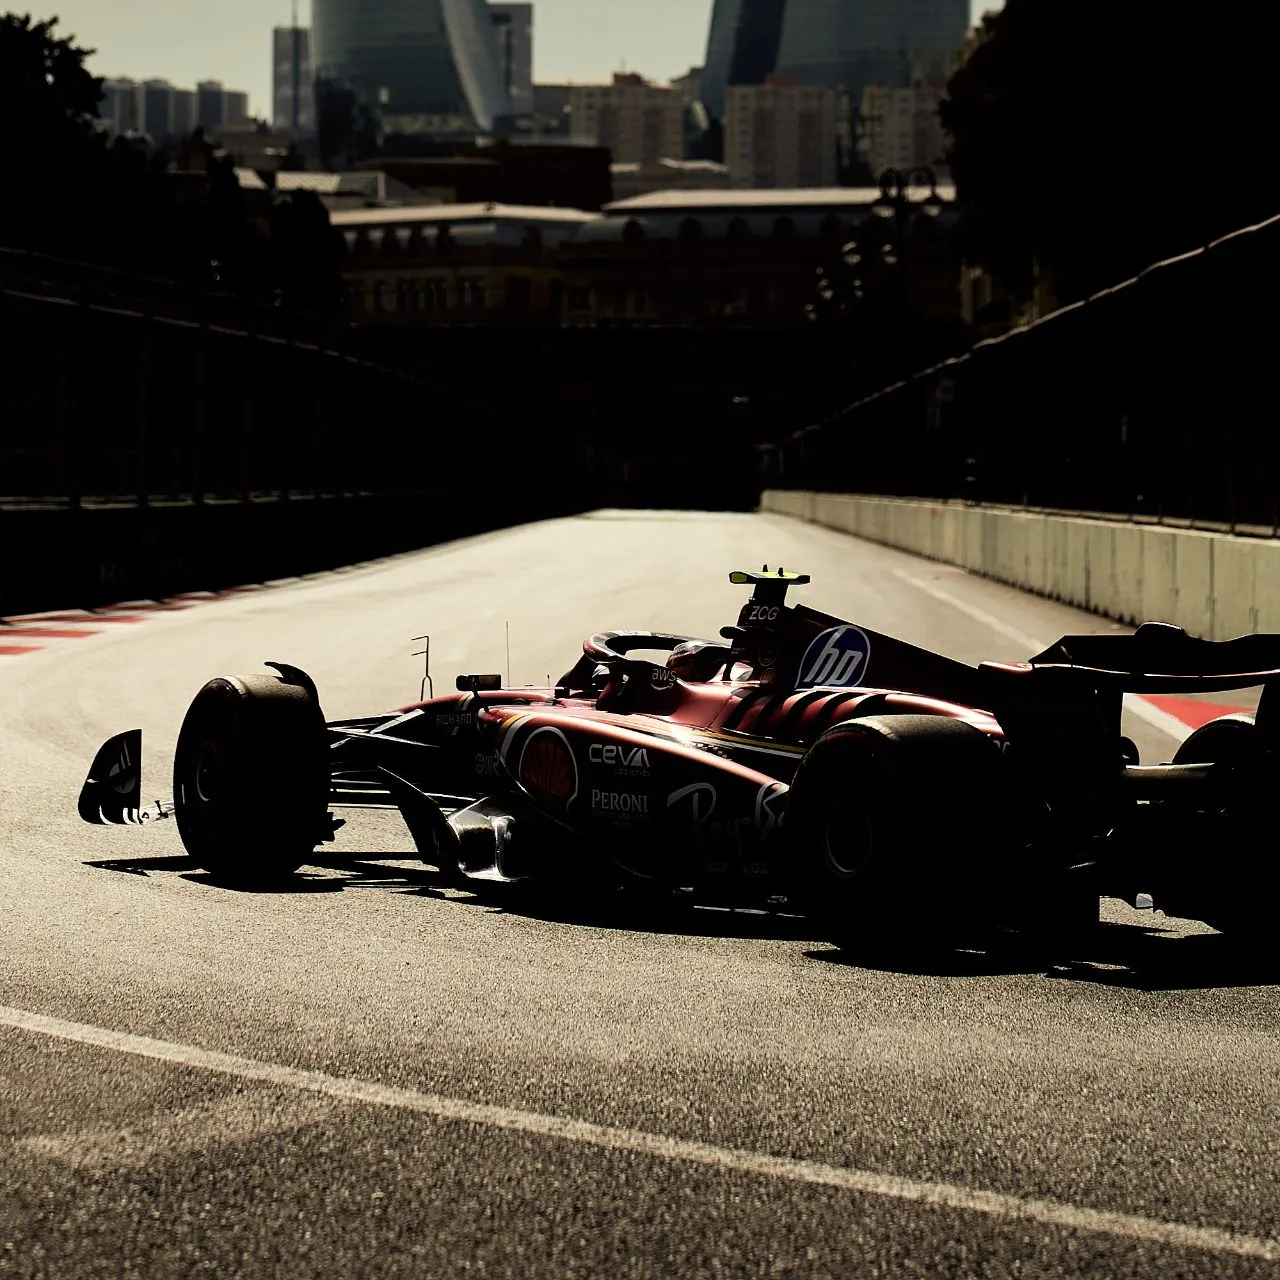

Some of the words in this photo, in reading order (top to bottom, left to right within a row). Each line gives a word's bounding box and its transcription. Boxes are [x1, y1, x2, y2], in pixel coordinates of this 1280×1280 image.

[803, 625, 863, 686] hp
[652, 668, 677, 682] aws
[592, 789, 648, 813] PERONI
